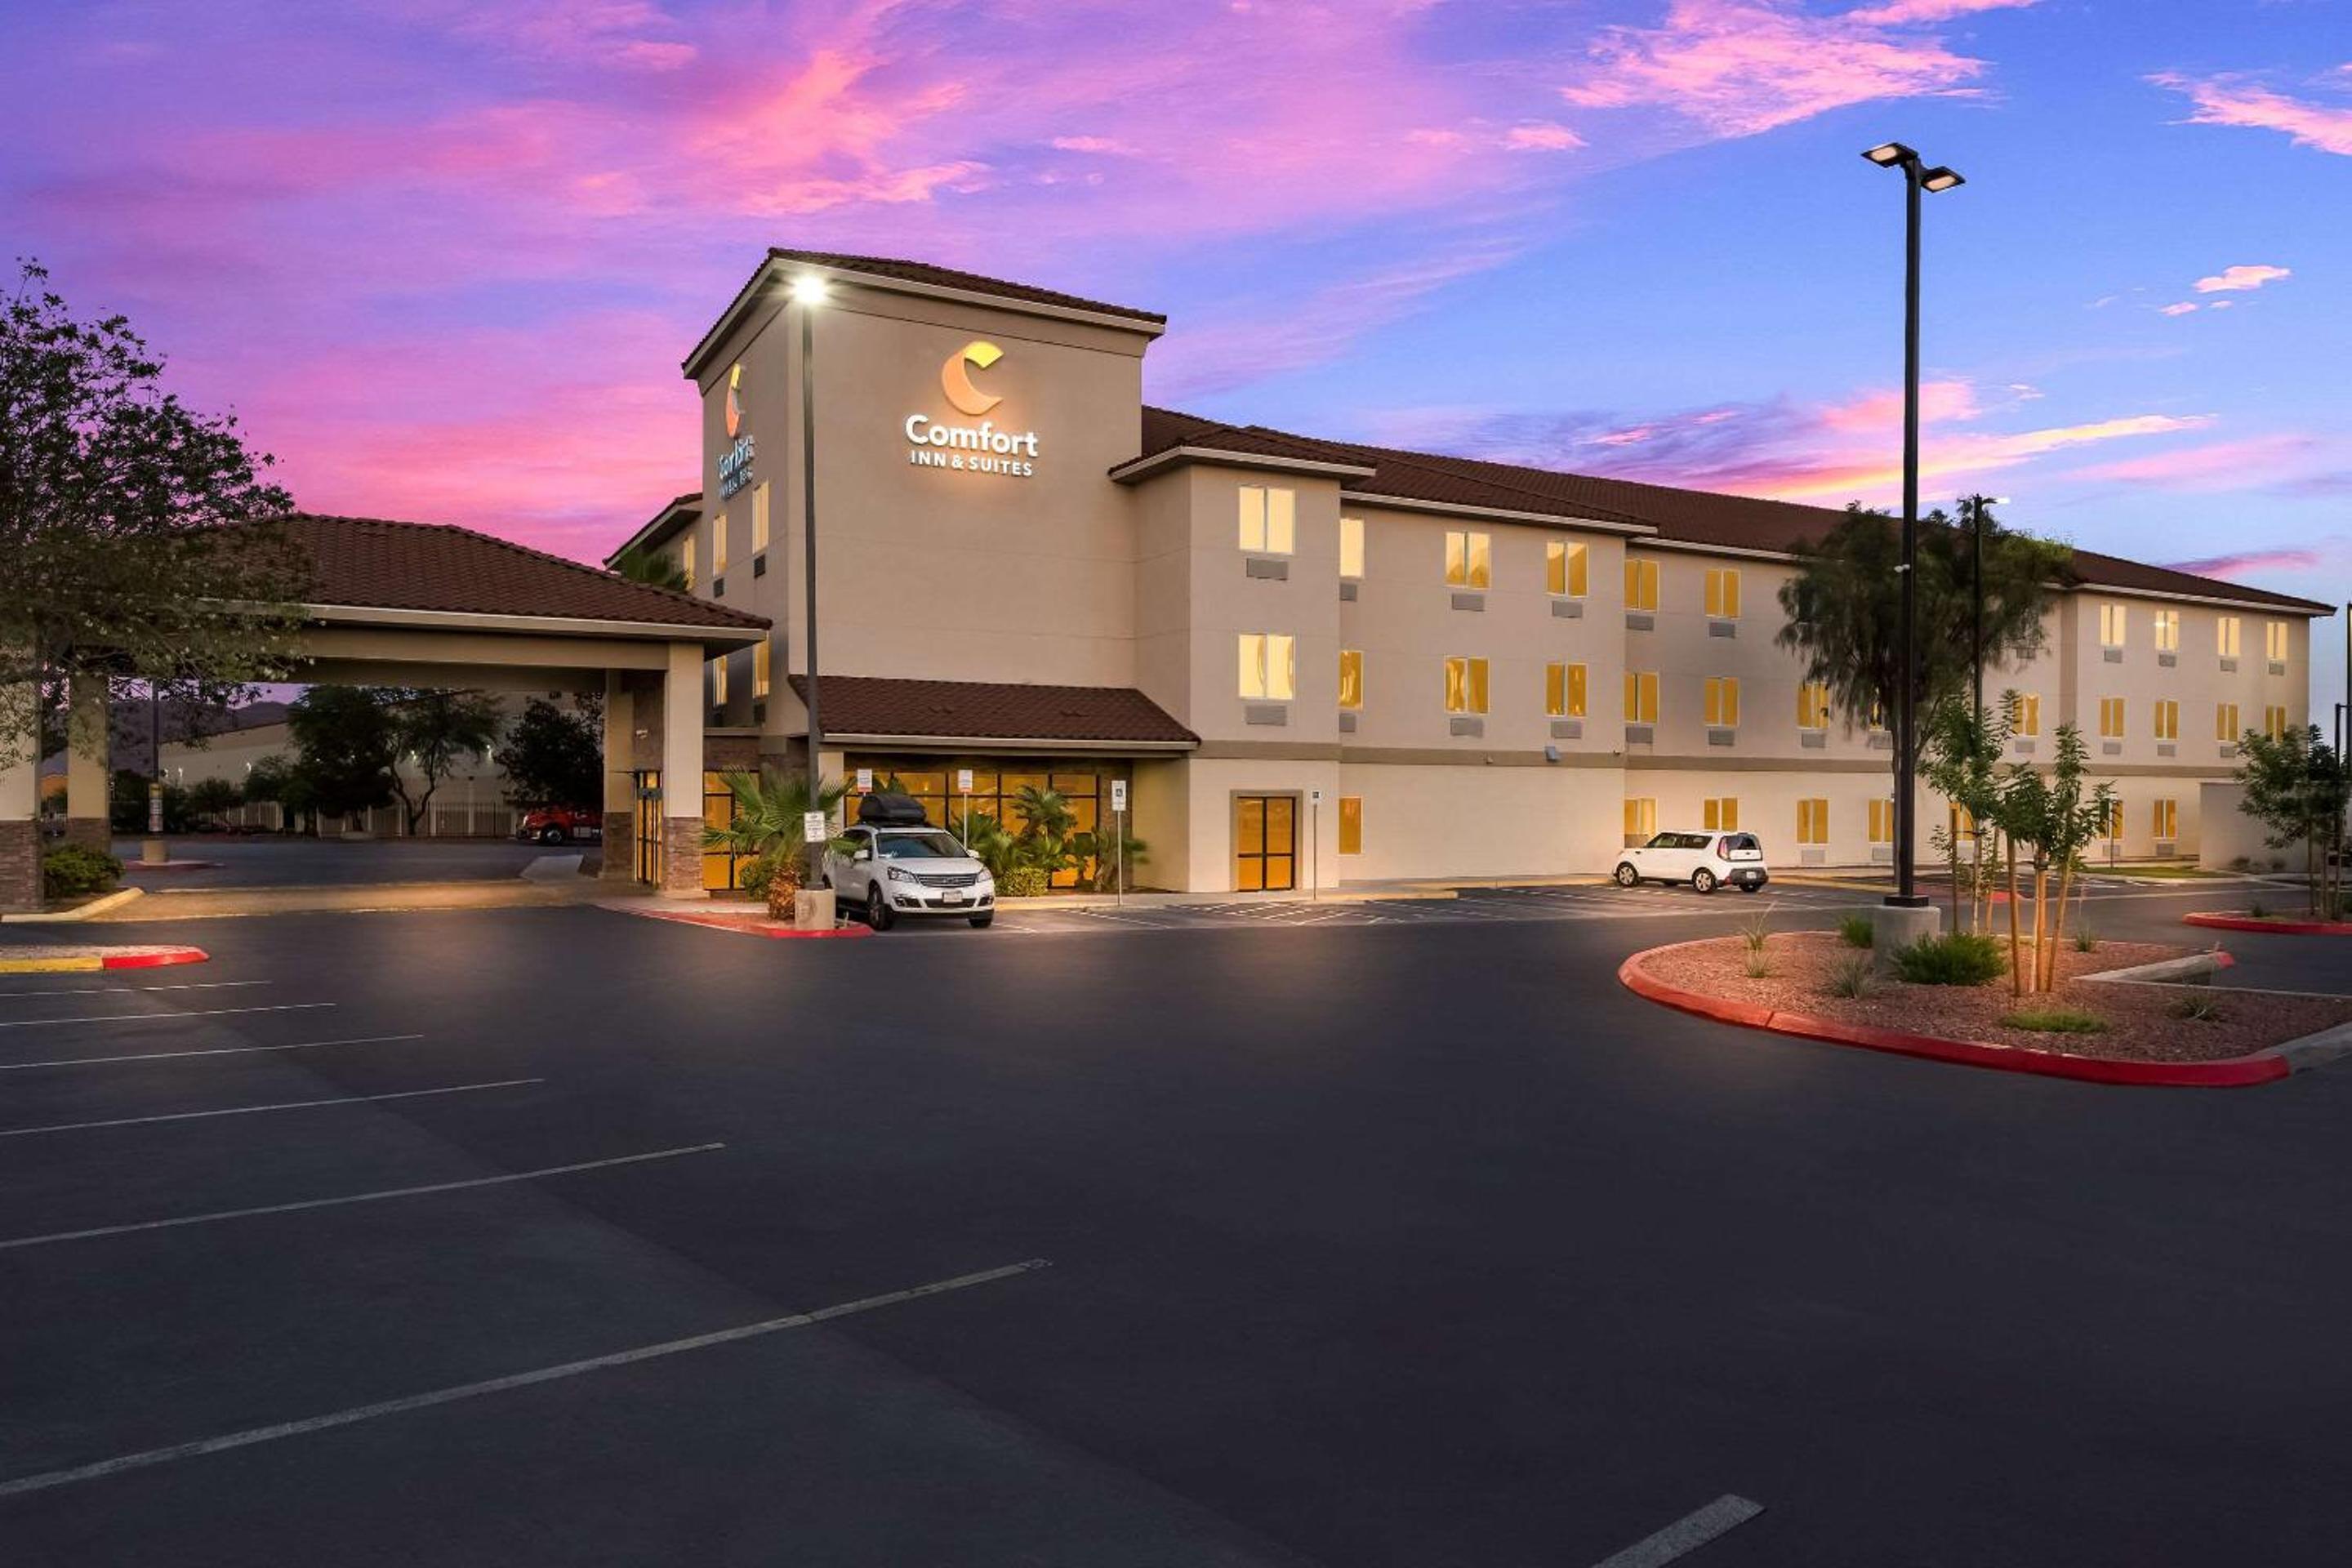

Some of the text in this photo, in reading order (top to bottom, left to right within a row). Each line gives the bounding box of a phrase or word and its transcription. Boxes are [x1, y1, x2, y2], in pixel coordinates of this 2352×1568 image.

[905, 414, 1039, 457] Comfort
[911, 450, 1033, 477] INN & SUITES
